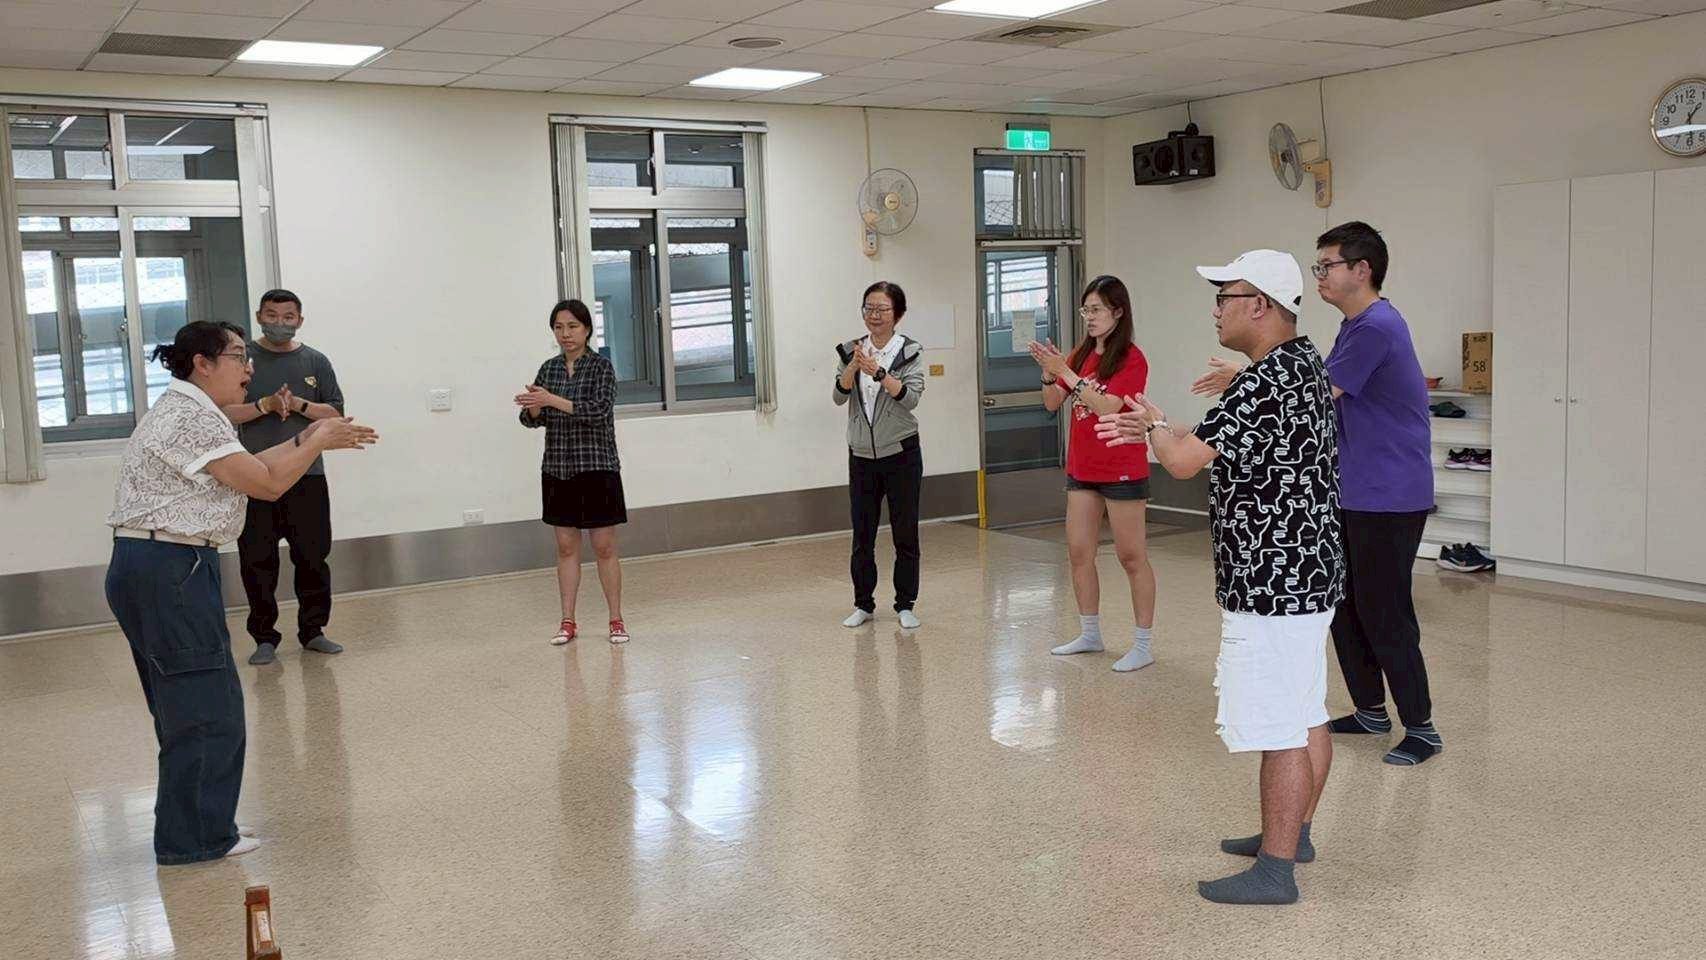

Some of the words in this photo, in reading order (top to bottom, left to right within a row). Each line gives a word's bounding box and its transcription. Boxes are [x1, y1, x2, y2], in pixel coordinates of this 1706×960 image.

[1676, 94, 1684, 103] 11
[1686, 89, 1696, 99] 12
[1667, 104, 1677, 114] 10
[1662, 116, 1669, 125] 9
[1473, 360, 1486, 373] 58
